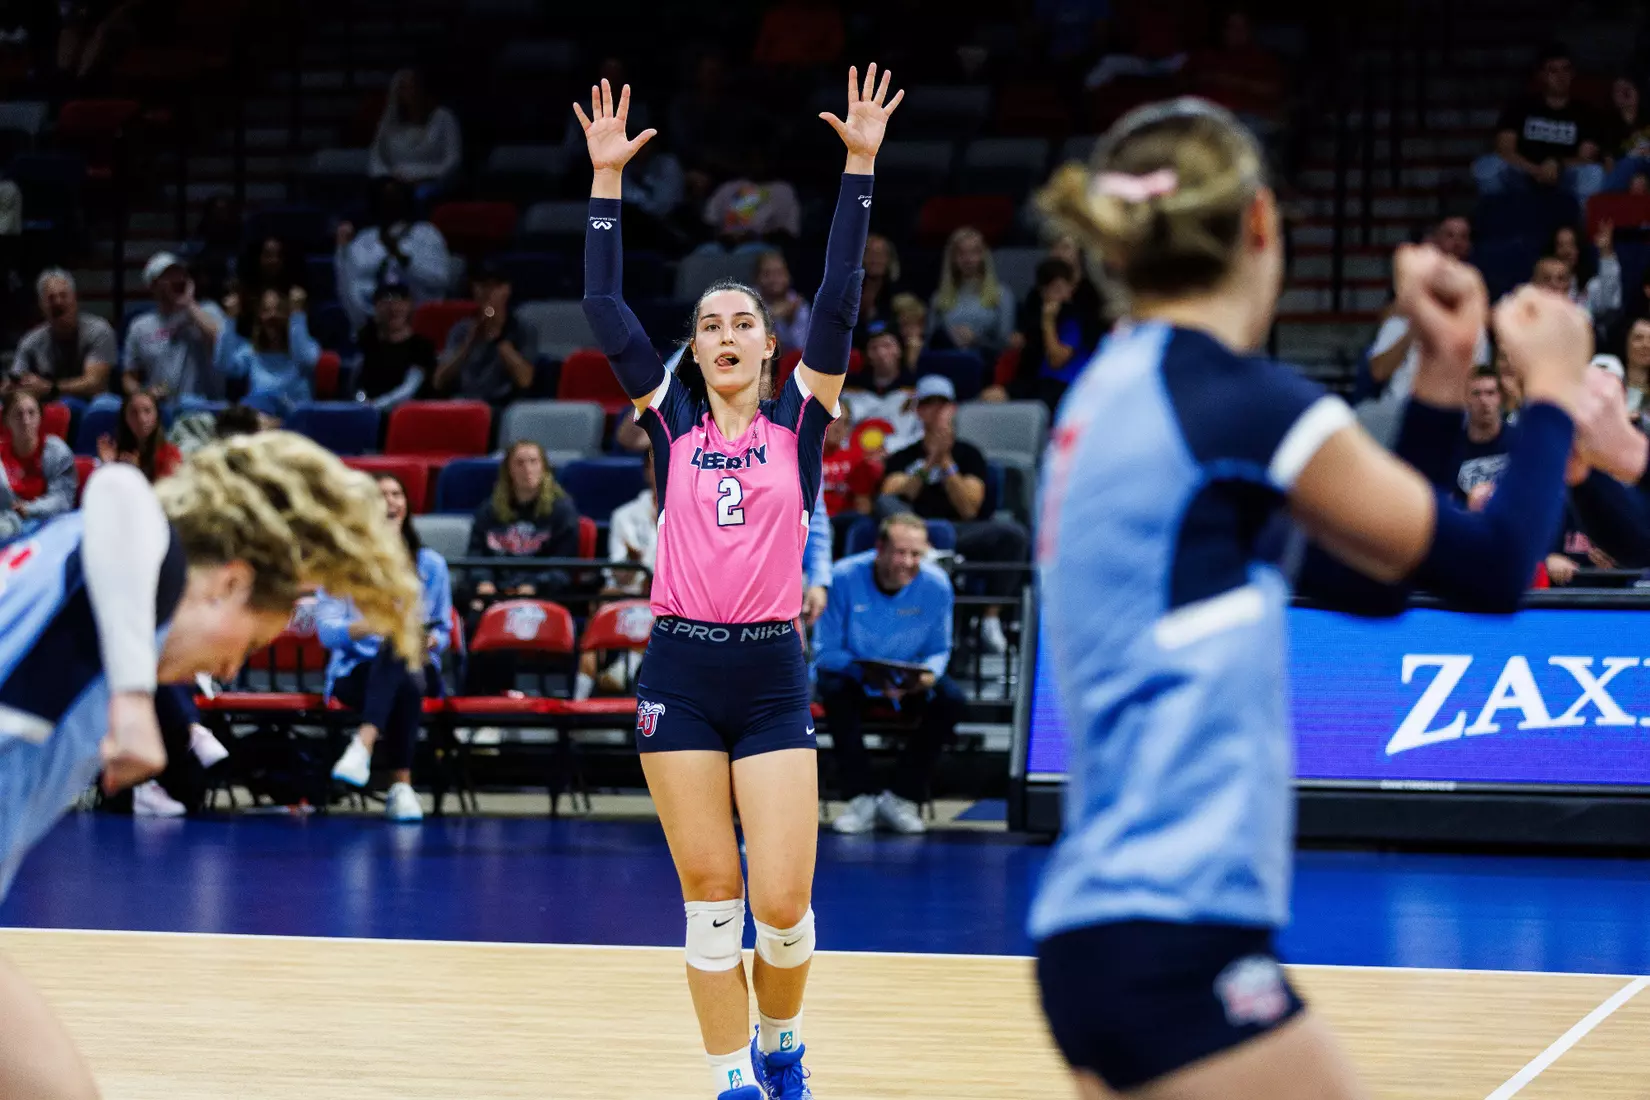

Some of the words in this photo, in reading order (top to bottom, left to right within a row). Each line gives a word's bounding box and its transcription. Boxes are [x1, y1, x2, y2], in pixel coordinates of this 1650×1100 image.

[690, 443, 768, 470] LBERTY
[716, 475, 746, 527] 2
[672, 621, 731, 643] PRO
[740, 623, 791, 642] NIKE
[1385, 654, 1650, 756] ZAX
